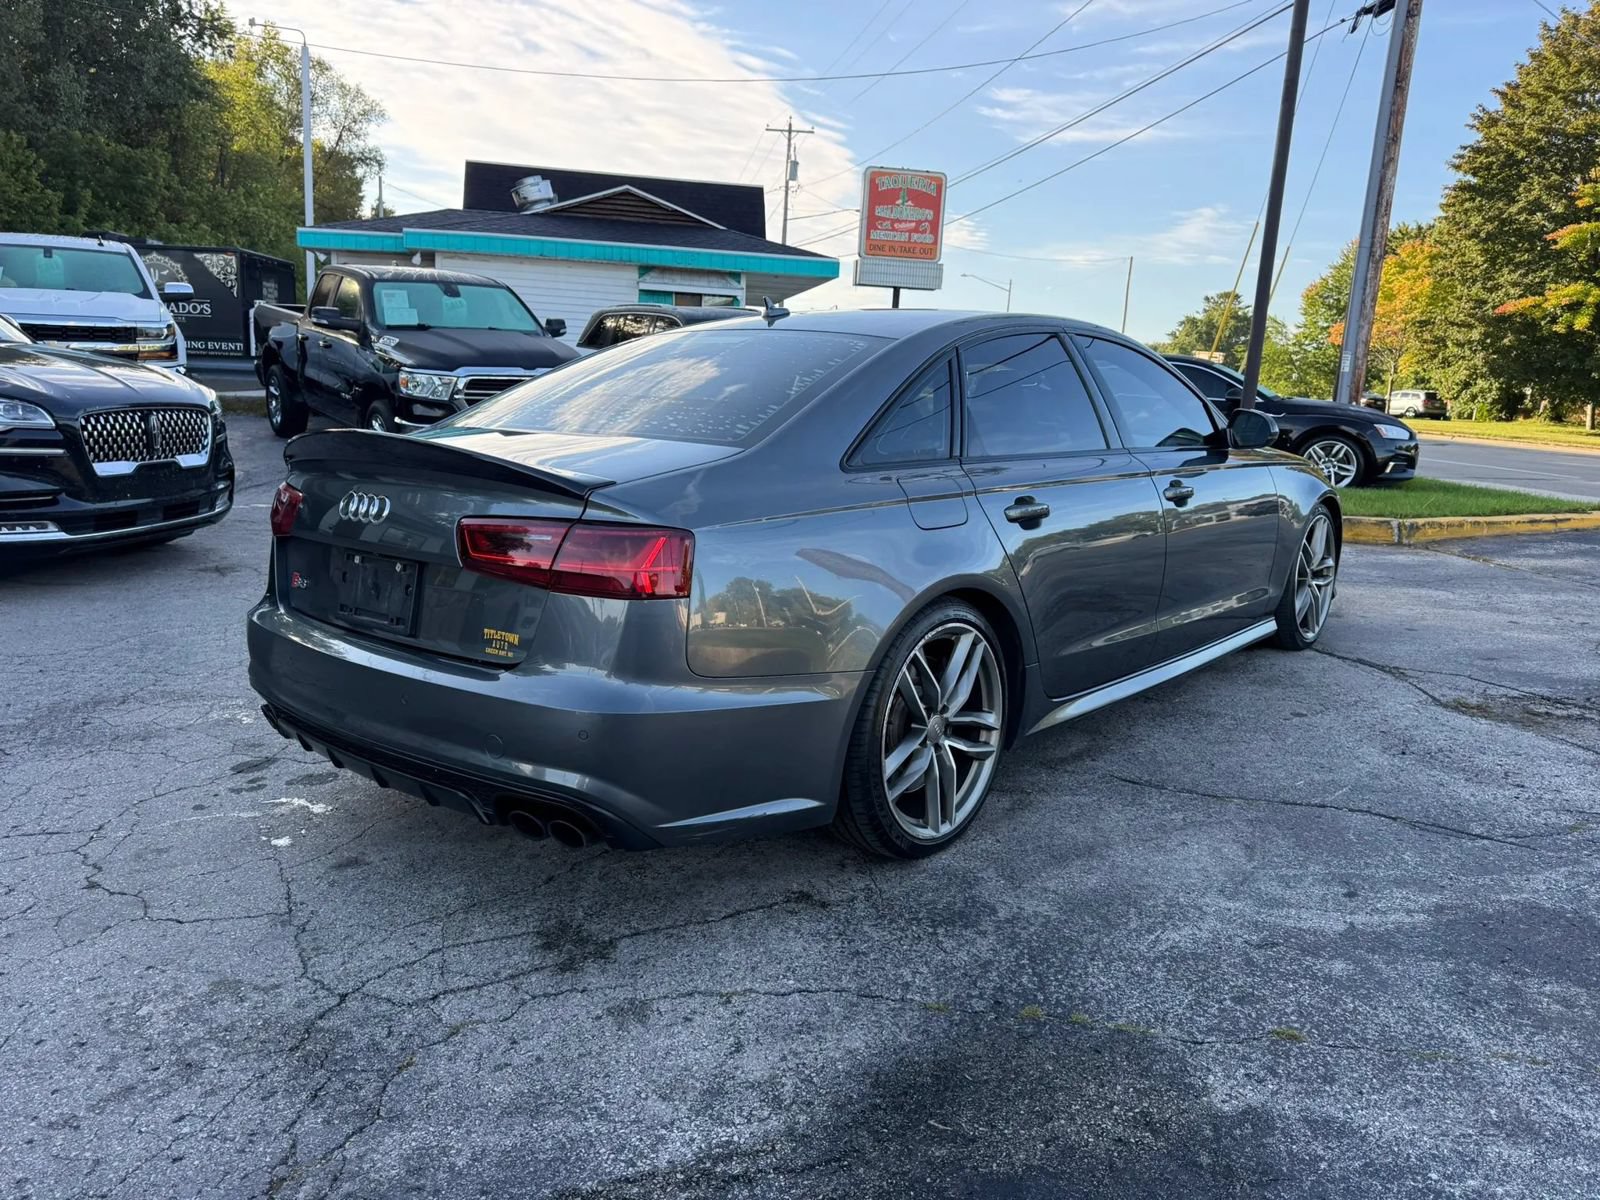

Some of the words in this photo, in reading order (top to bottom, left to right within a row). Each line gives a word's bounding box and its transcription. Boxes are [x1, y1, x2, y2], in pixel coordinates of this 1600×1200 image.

[876, 175, 937, 196] TAQUERIA
[870, 230, 909, 241] MEXICAN
[911, 233, 934, 243] FOOD
[869, 243, 887, 252] DINE
[888, 245, 917, 255] IN/TAKE
[919, 248, 934, 256] OUT
[484, 628, 519, 646] TITLETOWN
